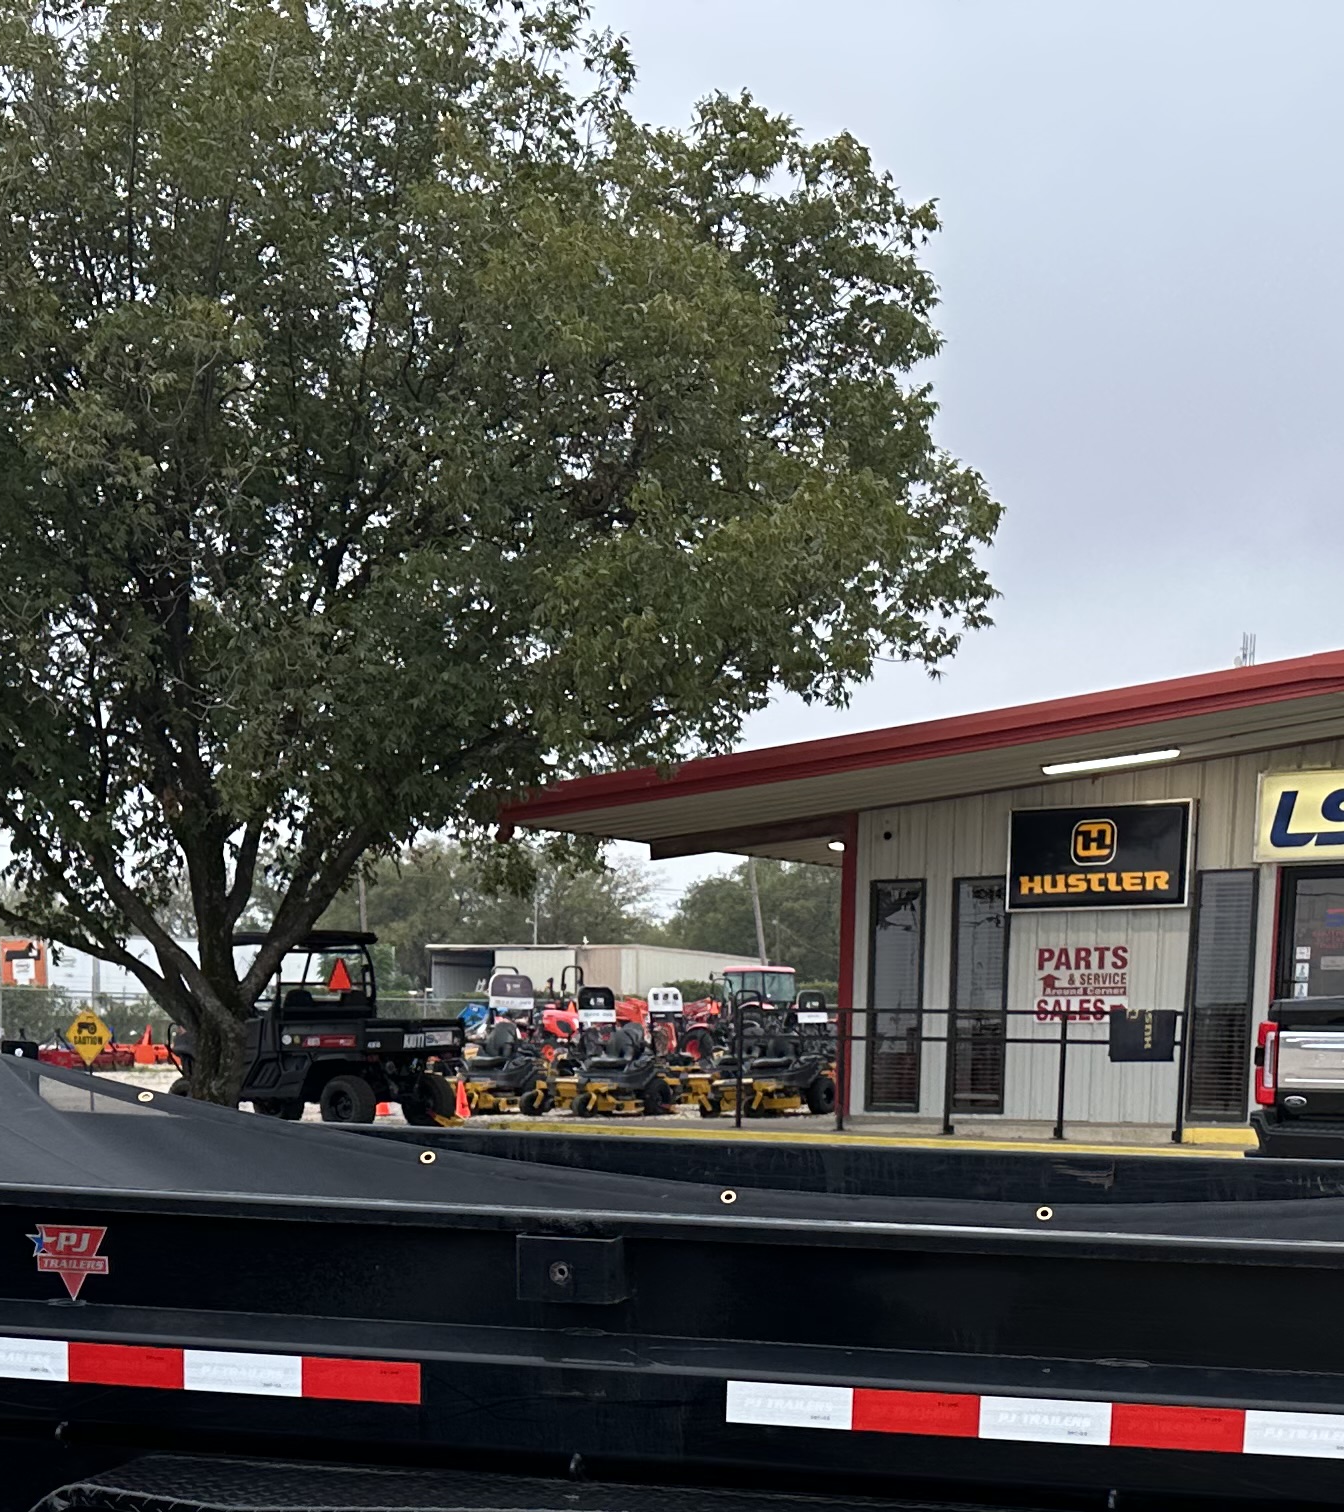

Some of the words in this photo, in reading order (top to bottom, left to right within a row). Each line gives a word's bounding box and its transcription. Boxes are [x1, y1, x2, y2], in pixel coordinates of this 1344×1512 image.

[1019, 870, 1170, 895] HUSTLER
[1037, 945, 1129, 971] PARTS
[1067, 973, 1076, 986] &
[1079, 972, 1127, 986] SERVICE
[1044, 987, 1084, 996] Around
[1087, 987, 1125, 996] Corner
[1036, 998, 1106, 1022] SALES
[73, 1035, 103, 1046] CAUTION
[56, 1232, 91, 1253] PJ
[43, 1258, 105, 1271] TRAILERS
